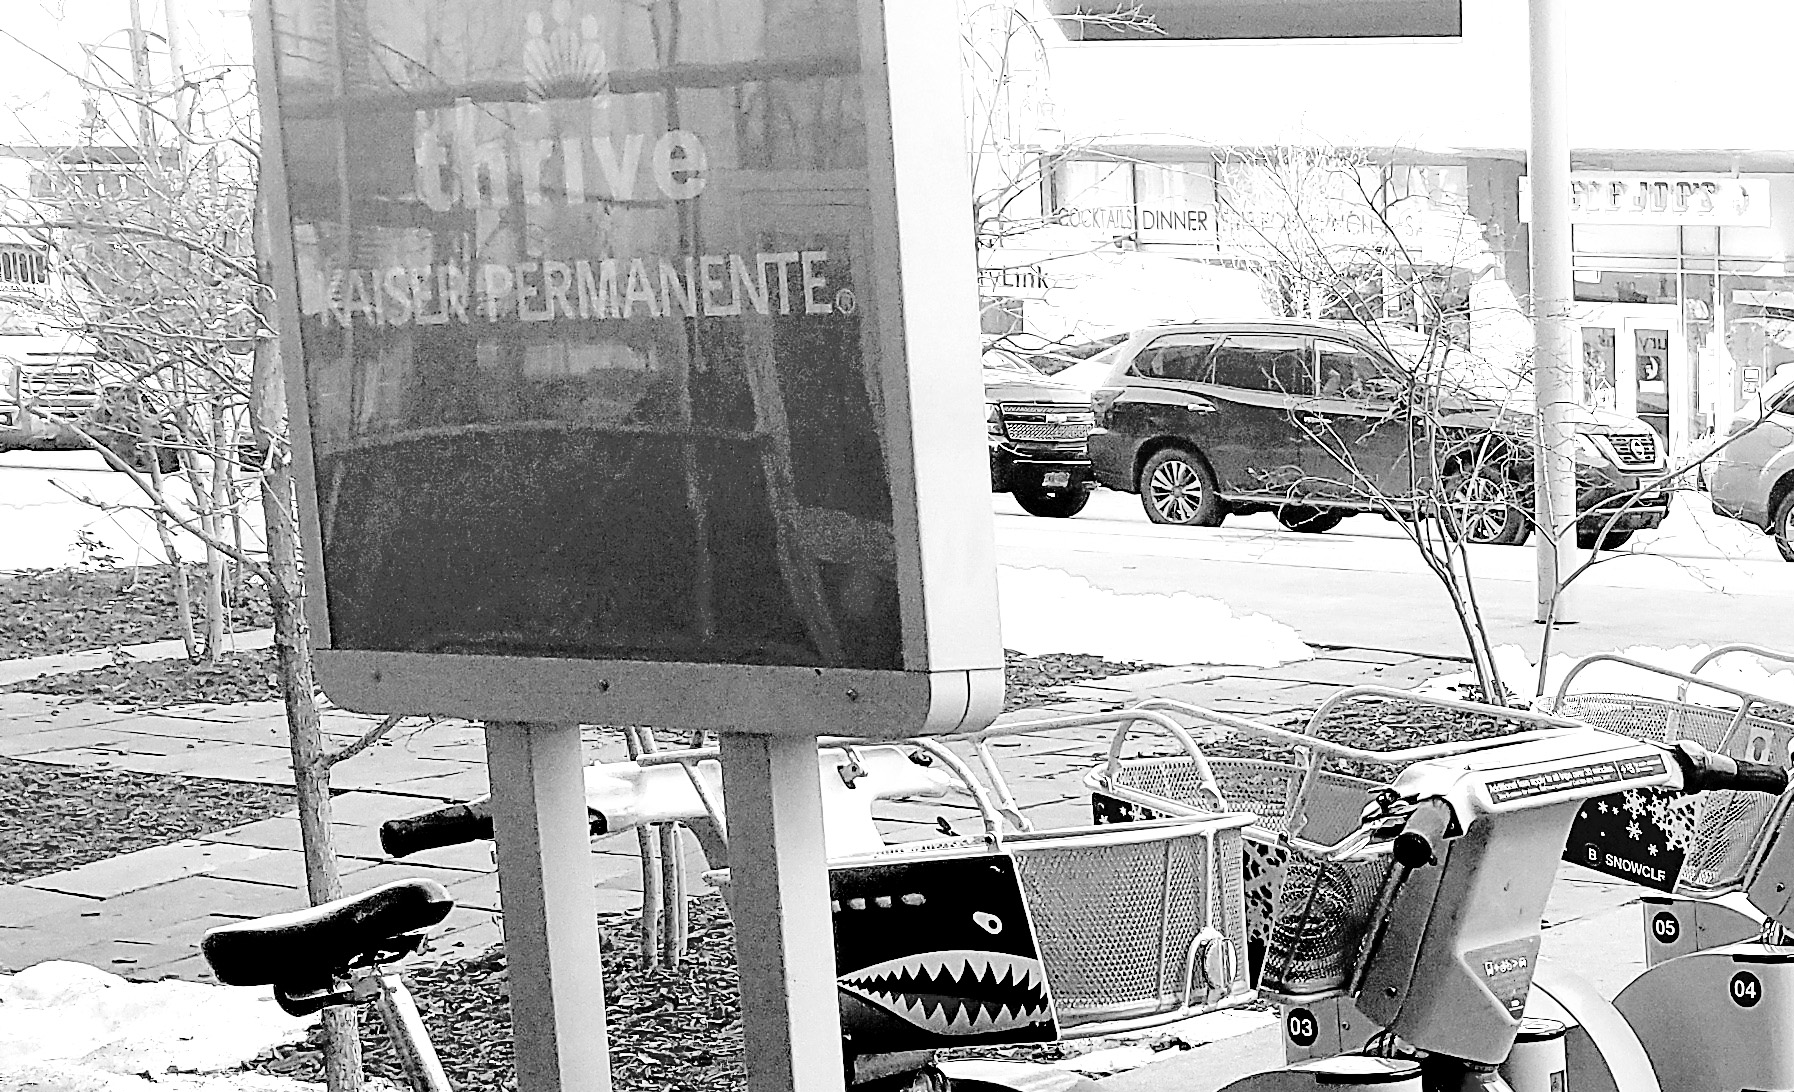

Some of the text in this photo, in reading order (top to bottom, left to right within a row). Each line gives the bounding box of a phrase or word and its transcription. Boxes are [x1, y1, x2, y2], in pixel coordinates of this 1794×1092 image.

[414, 97, 707, 212] thrive
[1142, 210, 1208, 232] DINNER
[320, 250, 834, 330] KAISER PERMANENTE
[1655, 919, 1676, 936] 05
[1734, 979, 1757, 999] 04
[1289, 1016, 1314, 1037] 03
